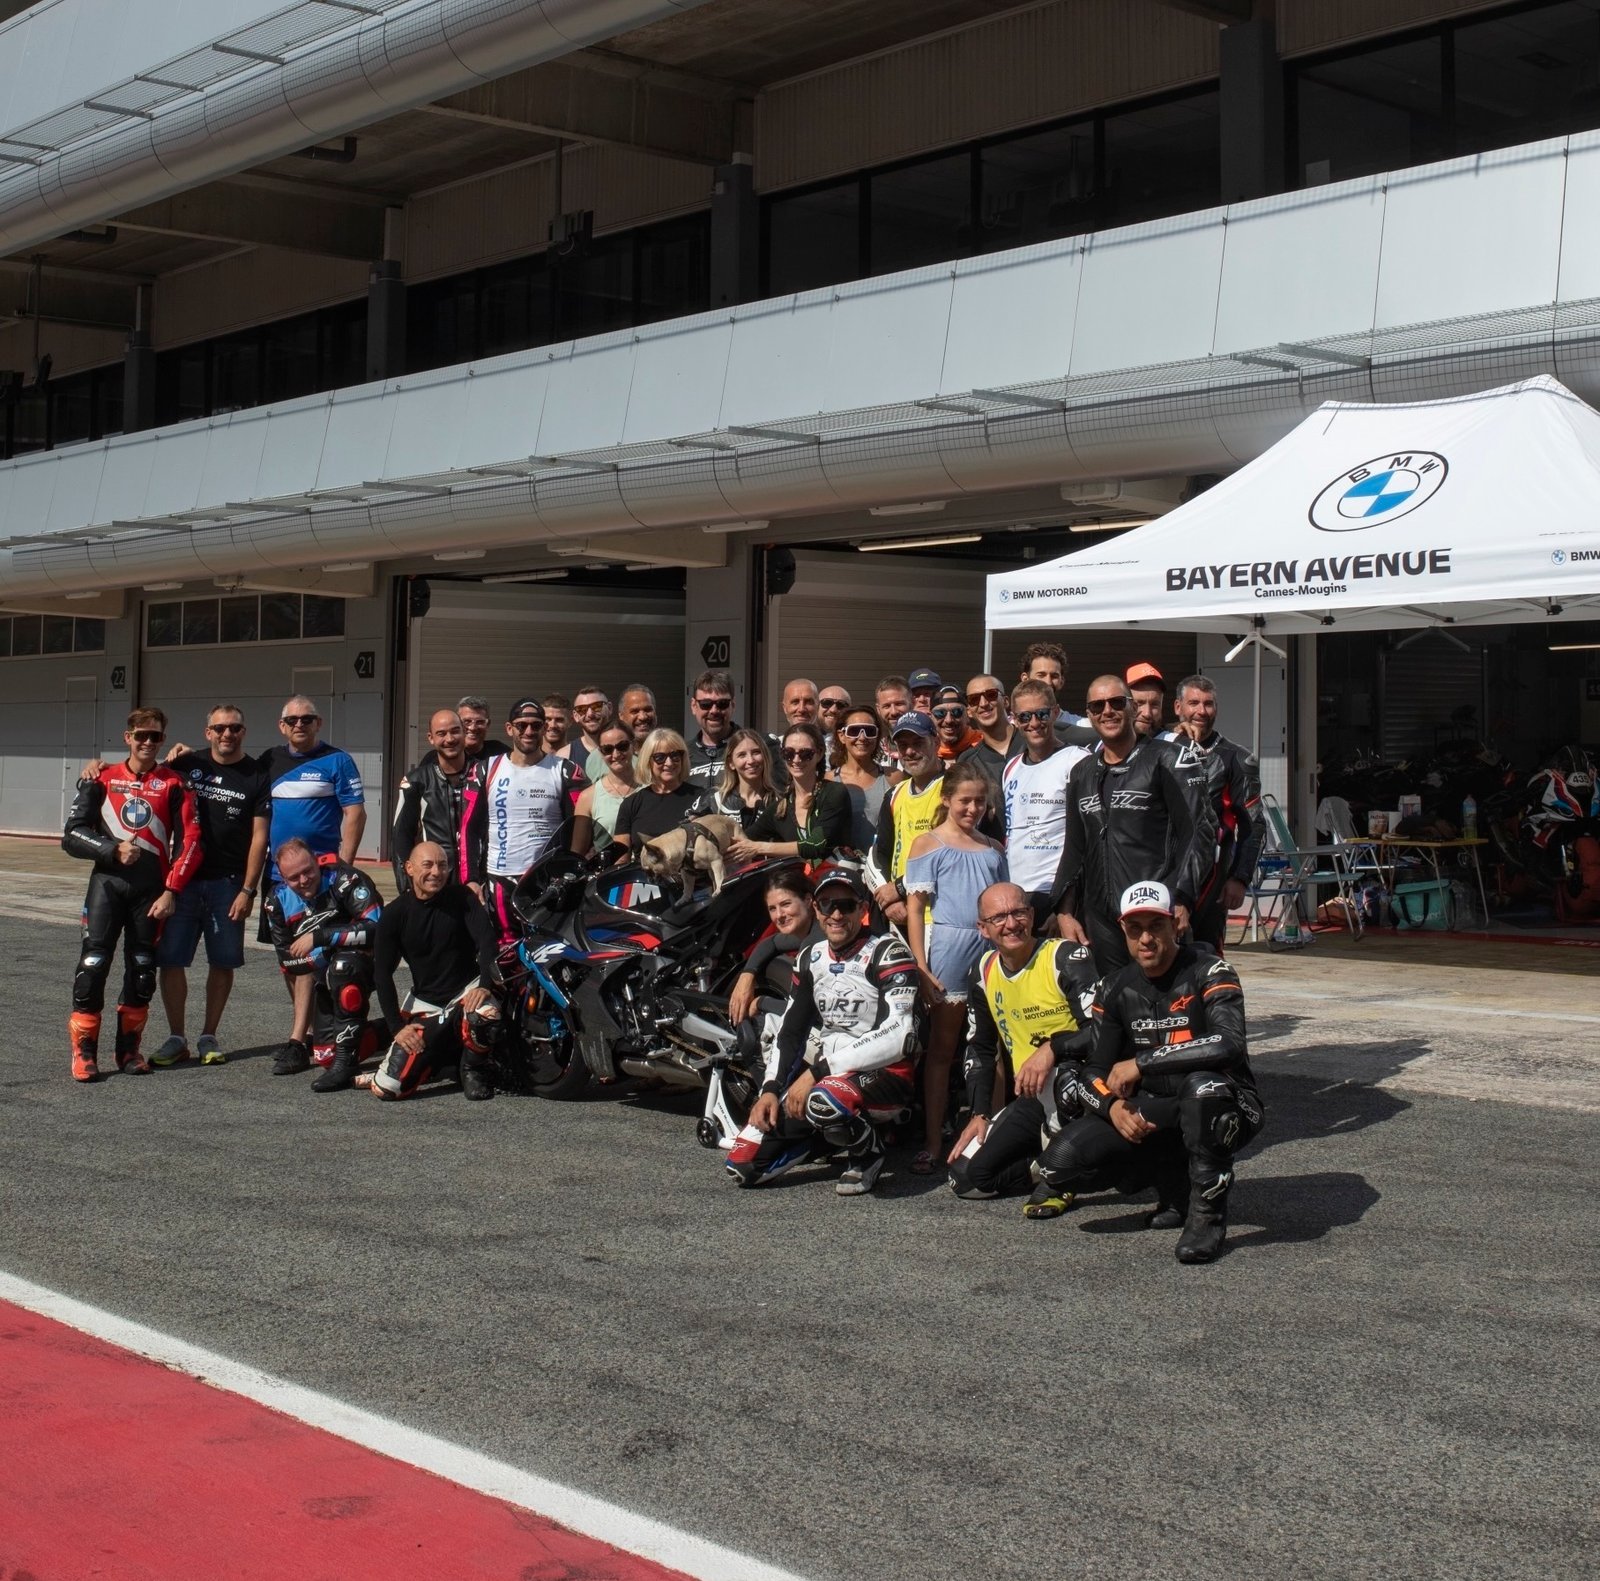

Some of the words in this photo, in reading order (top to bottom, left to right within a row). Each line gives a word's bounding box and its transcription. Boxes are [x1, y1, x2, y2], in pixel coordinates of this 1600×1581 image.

[1348, 455, 1440, 483] BMW
[1570, 550, 1600, 562] BMW
[1166, 559, 1299, 592] BAYERN
[1303, 547, 1453, 583] AVENUE
[1012, 590, 1035, 600] BMW
[1037, 586, 1088, 598] MOTORRAD
[1254, 582, 1347, 598] Cannes-Mougins
[707, 640, 729, 663] 20
[358, 655, 372, 674] 21
[113, 669, 125, 686] 22
[204, 785, 247, 801] MOTORRAD
[494, 776, 511, 870] TRACKDAYS
[1128, 886, 1160, 904] ASTARS
[1022, 1005, 1041, 1013] BMW
[1024, 1005, 1067, 1021] MOTORRAD
[852, 1038, 871, 1049] BMW
